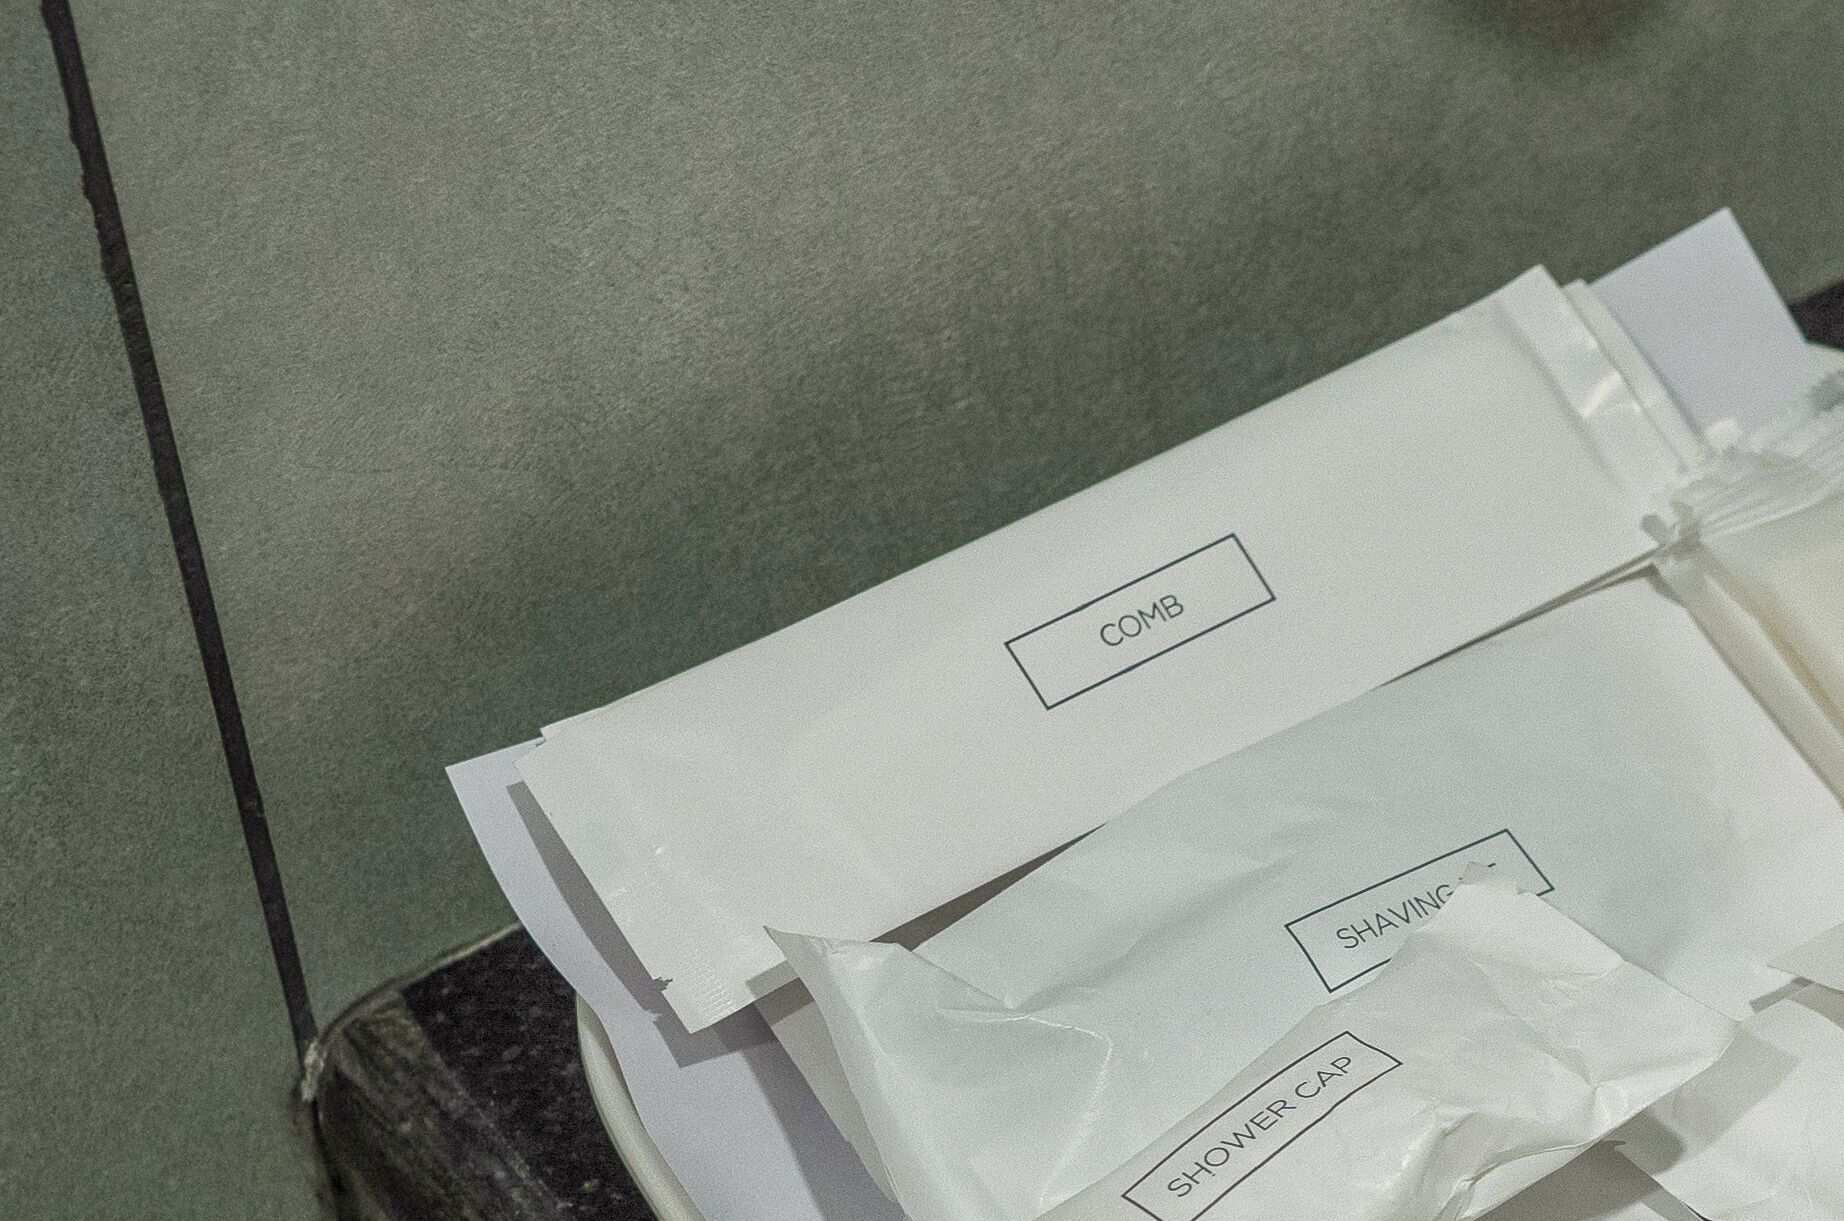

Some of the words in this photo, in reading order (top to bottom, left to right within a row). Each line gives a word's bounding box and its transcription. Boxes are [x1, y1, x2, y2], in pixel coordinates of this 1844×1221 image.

[1100, 594, 1184, 646] COMB
[1336, 884, 1454, 949] SHAVING
[1167, 1099, 1297, 1198] SHOWER
[1294, 1056, 1352, 1099] CAP
